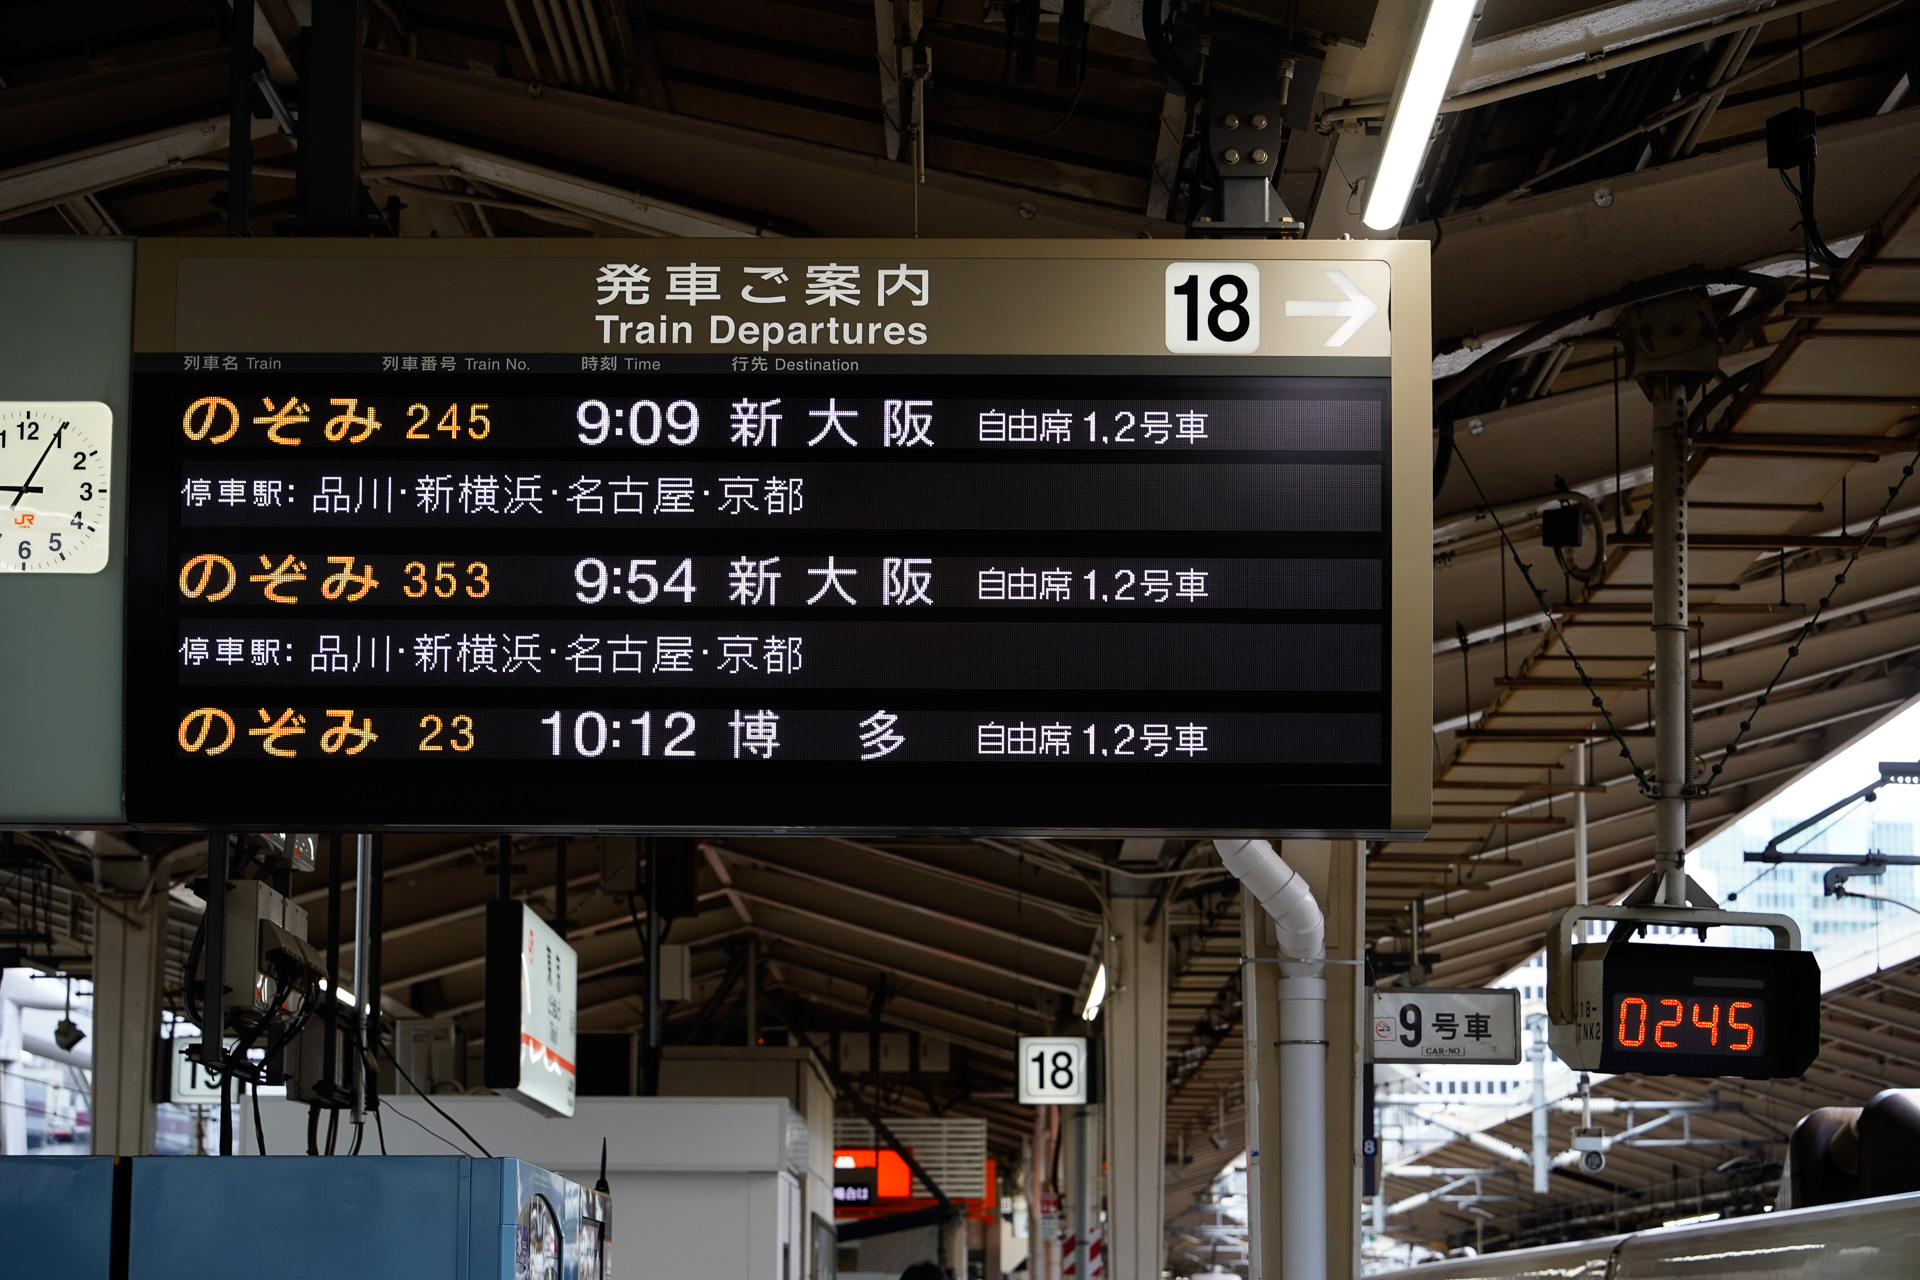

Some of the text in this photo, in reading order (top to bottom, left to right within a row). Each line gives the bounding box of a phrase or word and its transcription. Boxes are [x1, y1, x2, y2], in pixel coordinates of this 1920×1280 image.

[597, 263, 928, 306] 発車ご案内
[1175, 275, 1249, 342] 18
[596, 315, 927, 351] Train Departures
[185, 356, 280, 370] 列車名 Train
[383, 357, 529, 371] 列車番号 Train No.
[582, 356, 660, 370] 時刻 Time
[732, 357, 858, 371] 行先 Destination
[17, 421, 39, 440] 12
[183, 397, 382, 446] のぞみ
[407, 403, 490, 439] 245
[577, 400, 699, 445] 9:09
[730, 398, 934, 447] 新大阪
[73, 452, 86, 470] 2
[80, 482, 93, 501] 3
[14, 514, 34, 525] JR
[70, 511, 84, 529] 4
[18, 541, 32, 560] 6
[48, 533, 62, 552] 5
[180, 554, 379, 604] のぞみ
[404, 561, 489, 597] 353
[575, 558, 697, 604] 9:54
[729, 556, 933, 606] 新大阪
[179, 708, 378, 758] のぞみ
[419, 715, 474, 751] 23
[541, 711, 696, 757] 10:12
[1577, 1022, 1601, 1040] TNK2
[1618, 998, 1753, 1050] 0245
[1032, 1052, 1073, 1089] 18
